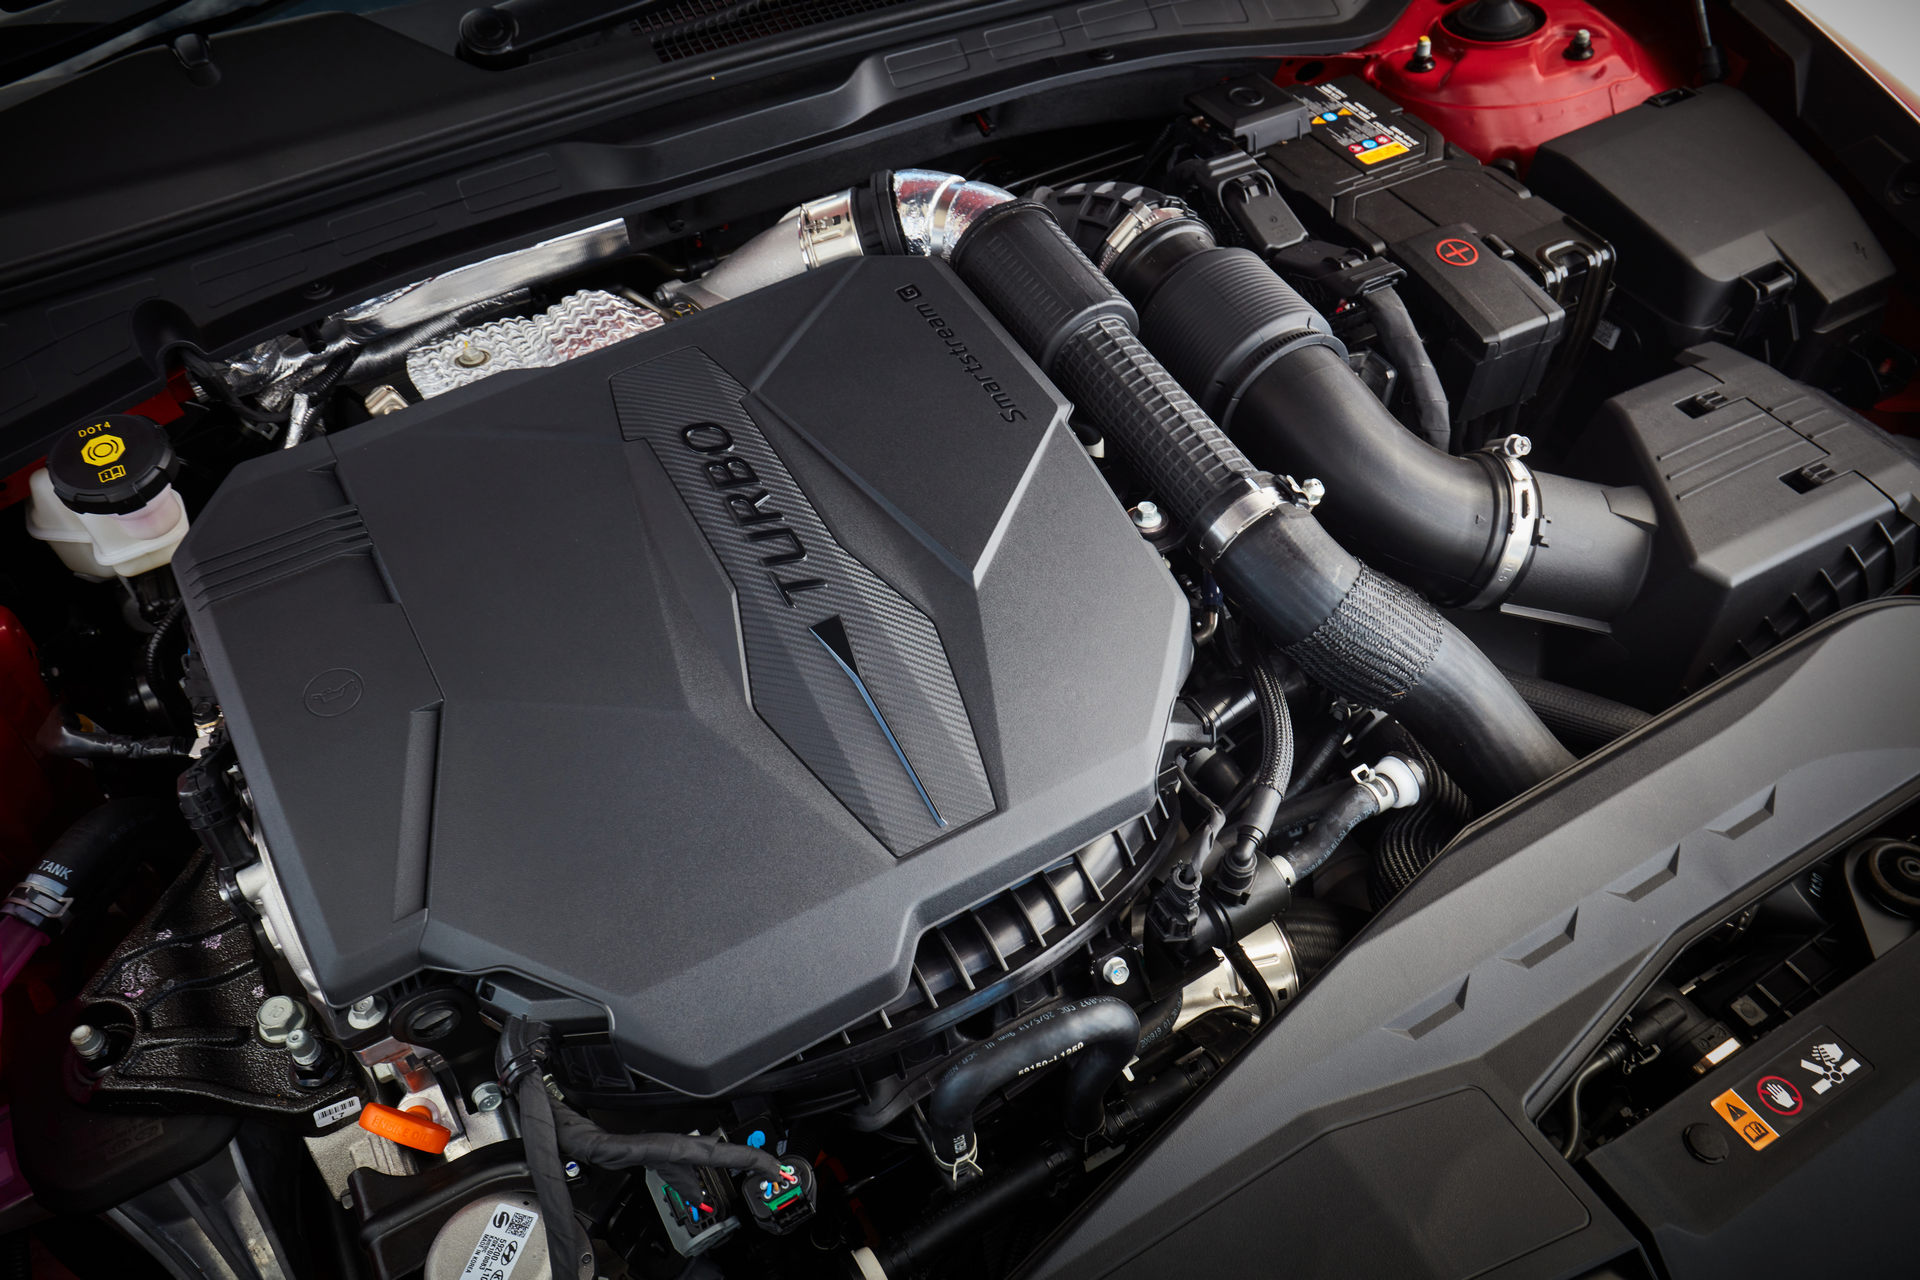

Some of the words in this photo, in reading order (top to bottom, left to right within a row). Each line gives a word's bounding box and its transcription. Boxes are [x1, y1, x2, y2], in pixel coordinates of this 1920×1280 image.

[914, 303, 1027, 423] Smartstream
[681, 422, 828, 608] TURBO
[38, 859, 73, 880] TANK
[371, 1115, 409, 1138] ENGINE
[411, 1130, 431, 1144] OIL
[478, 1234, 490, 1248] MADE
[465, 1256, 478, 1274] KOREA
